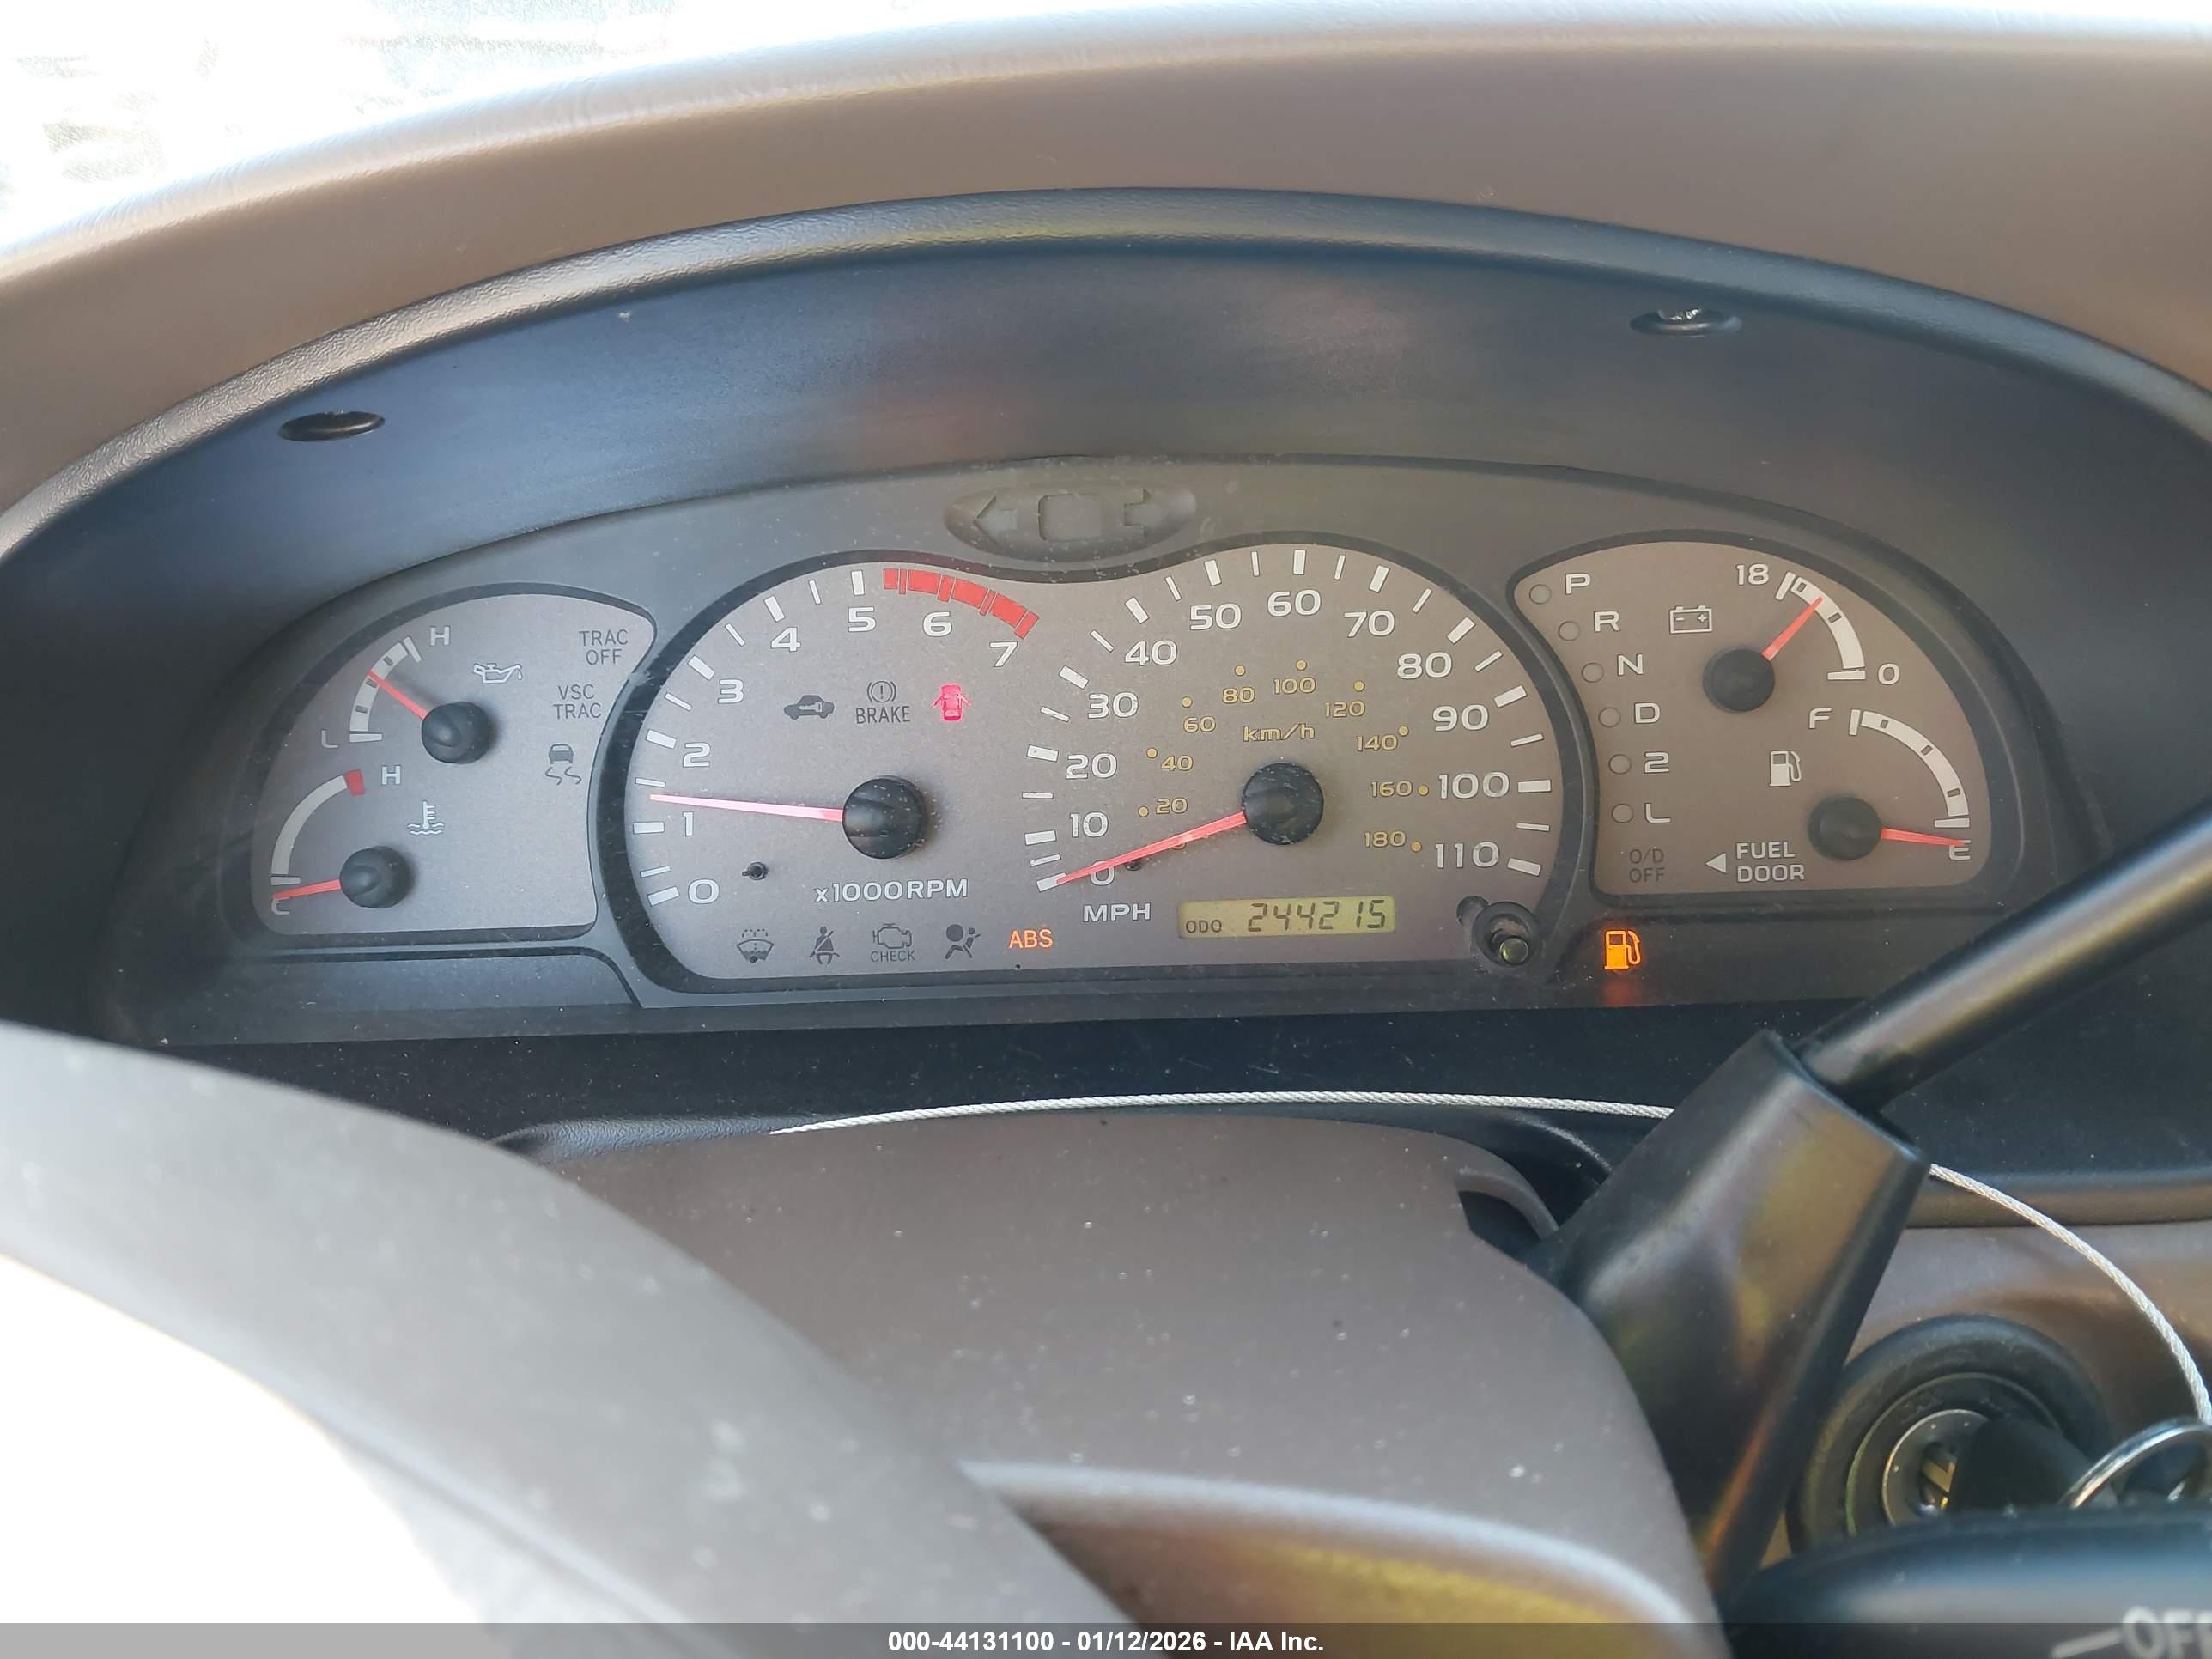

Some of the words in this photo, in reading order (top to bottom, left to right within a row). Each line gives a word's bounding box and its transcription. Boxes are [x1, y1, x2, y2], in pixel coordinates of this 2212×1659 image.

[1565, 573, 1590, 595] P
[1736, 563, 1769, 586] 18
[1267, 589, 1320, 617] 60
[848, 606, 876, 632] 5
[922, 611, 952, 637] 6
[1190, 604, 1242, 630] 50
[1345, 611, 1395, 638] 70
[1594, 611, 1621, 632] R
[429, 625, 451, 646] H
[579, 629, 628, 646] TRAC
[770, 627, 801, 653] 4
[586, 649, 622, 665] OFF
[989, 641, 1018, 667] 7
[1124, 641, 1177, 666] 40
[1398, 653, 1453, 680] 80
[1617, 653, 1643, 677] N
[1878, 663, 1899, 685] 0
[558, 684, 594, 700] VSC
[717, 678, 744, 704] 3
[1222, 687, 1255, 704] 80
[1273, 677, 1317, 695] 100
[553, 702, 601, 720] TRAC
[856, 706, 910, 725] BRAKE
[1088, 692, 1139, 720] 30
[1326, 700, 1366, 719] 120
[1634, 702, 1660, 724] D
[1183, 716, 1216, 733] 60
[1432, 705, 1489, 732] 90
[1808, 708, 1832, 729] F
[322, 731, 338, 748] L
[1243, 723, 1315, 742] km/h
[1356, 734, 1398, 752] 140
[682, 742, 711, 768] 2
[1161, 755, 1194, 771] 40
[1644, 751, 1668, 774] 2
[381, 763, 401, 784] H
[1066, 753, 1117, 781] 20
[1370, 781, 1413, 798] 160
[1438, 771, 1510, 799] 100
[1156, 797, 1188, 815] 20
[1644, 803, 1671, 823] L
[682, 811, 694, 838] 1
[1070, 811, 1109, 838] 10
[1364, 830, 1407, 848] 180
[1948, 839, 1972, 860] E
[1436, 842, 1500, 869] 110
[1630, 849, 1663, 864] O/D
[1737, 842, 1796, 860] FUEL
[1090, 860, 1115, 886] 0
[1630, 868, 1662, 883] OFF
[1738, 864, 1804, 883] DOOR
[688, 878, 720, 904] 0
[1085, 902, 1151, 922] MPH
[1185, 919, 1223, 934] ODO
[1247, 899, 1387, 933] 244215
[1009, 928, 1054, 948] ABS
[871, 951, 915, 962] CHECK
